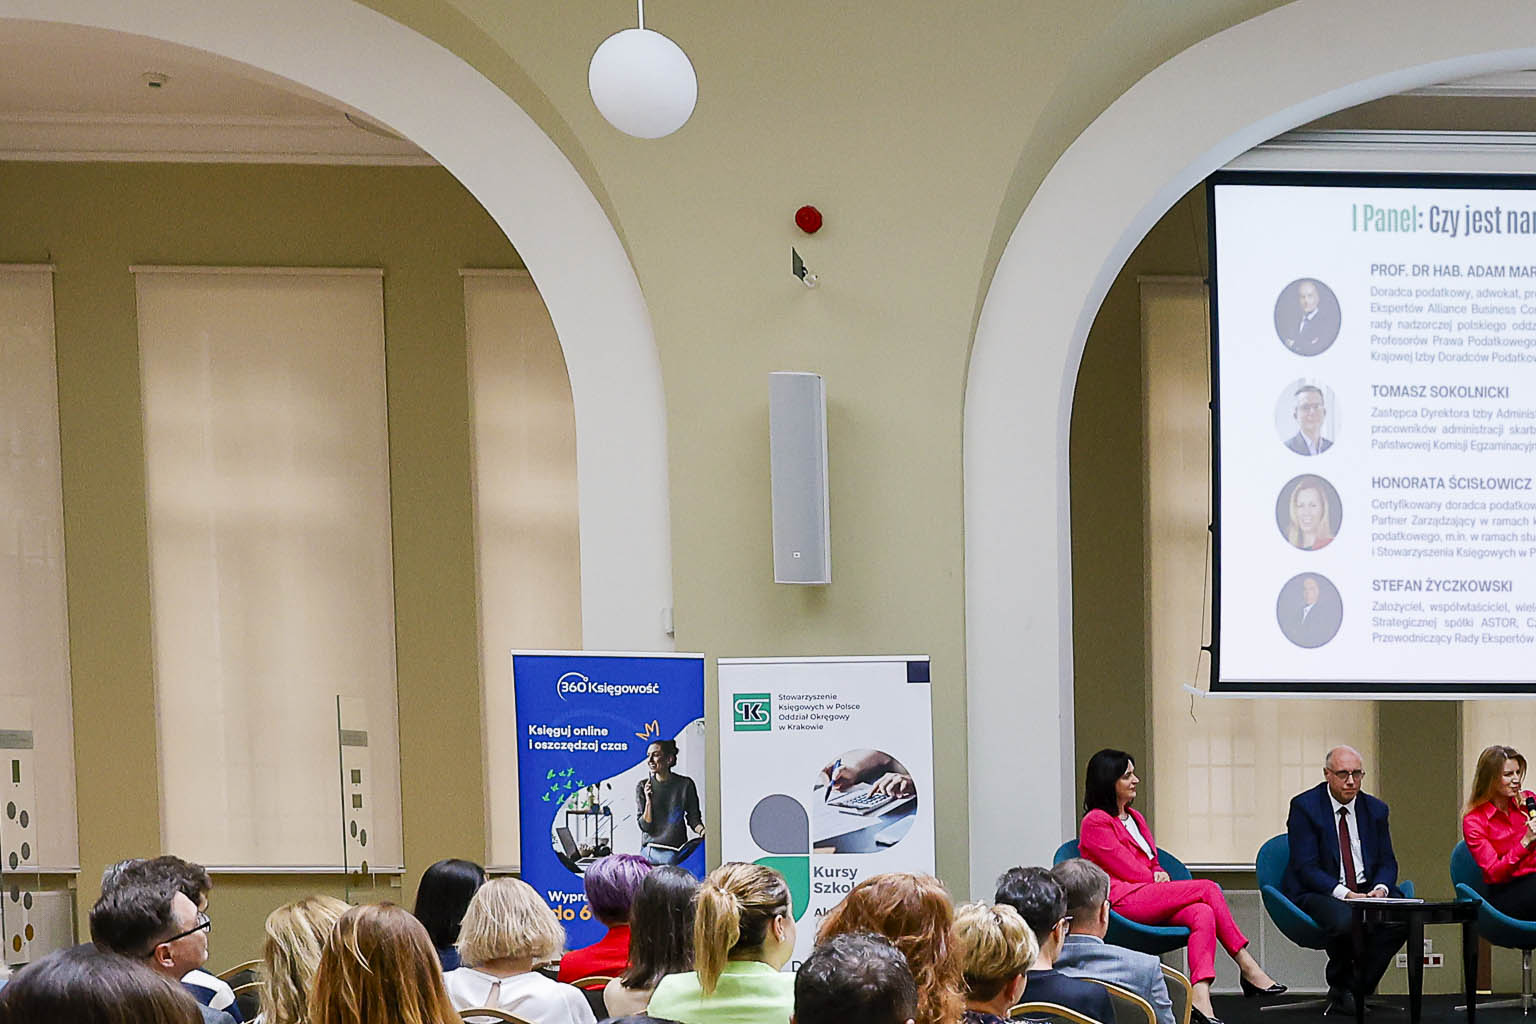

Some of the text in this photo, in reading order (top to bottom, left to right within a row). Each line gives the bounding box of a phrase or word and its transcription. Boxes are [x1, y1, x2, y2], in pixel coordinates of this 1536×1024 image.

[1353, 204, 1356, 231] I
[1364, 204, 1423, 232] Panel:
[1429, 205, 1459, 238] Czy
[1465, 204, 1501, 237] jest
[1371, 264, 1408, 276] PROF.
[1412, 264, 1429, 276] DR
[1433, 264, 1462, 277] HAB.
[1467, 265, 1505, 277] ADAM
[1371, 385, 1508, 398] TOMASZ SOKOLNICKI
[1372, 475, 1532, 490] HONORATA ŚCISŁOWICZ
[1372, 578, 1512, 592] STEFAN ŻYCZKOWSKI
[561, 682, 660, 696] 360 Księgowość
[778, 703, 825, 711] Księgowych
[810, 713, 850, 721] Okręgowy
[528, 724, 609, 738] Księguj online
[528, 739, 628, 752] i oszczędzaj czas
[813, 866, 858, 880] Kursy
[552, 905, 575, 921] do
